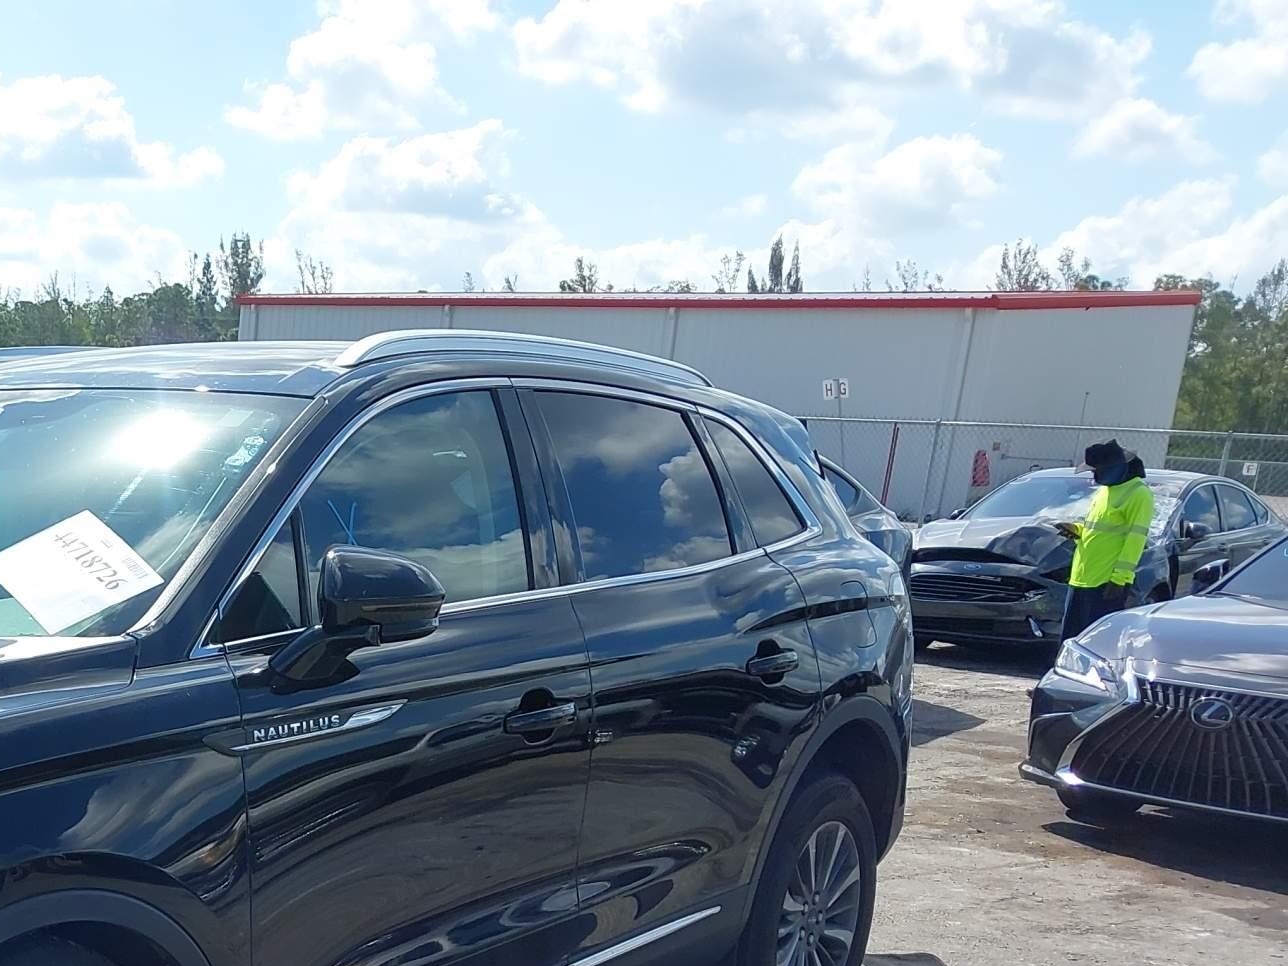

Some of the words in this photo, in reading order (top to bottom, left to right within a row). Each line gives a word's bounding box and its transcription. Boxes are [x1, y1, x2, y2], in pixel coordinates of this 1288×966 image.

[825, 383, 833, 397] H
[839, 382, 847, 396] G
[53, 531, 128, 591] 44718726
[253, 714, 341, 742] NAUTILUS
